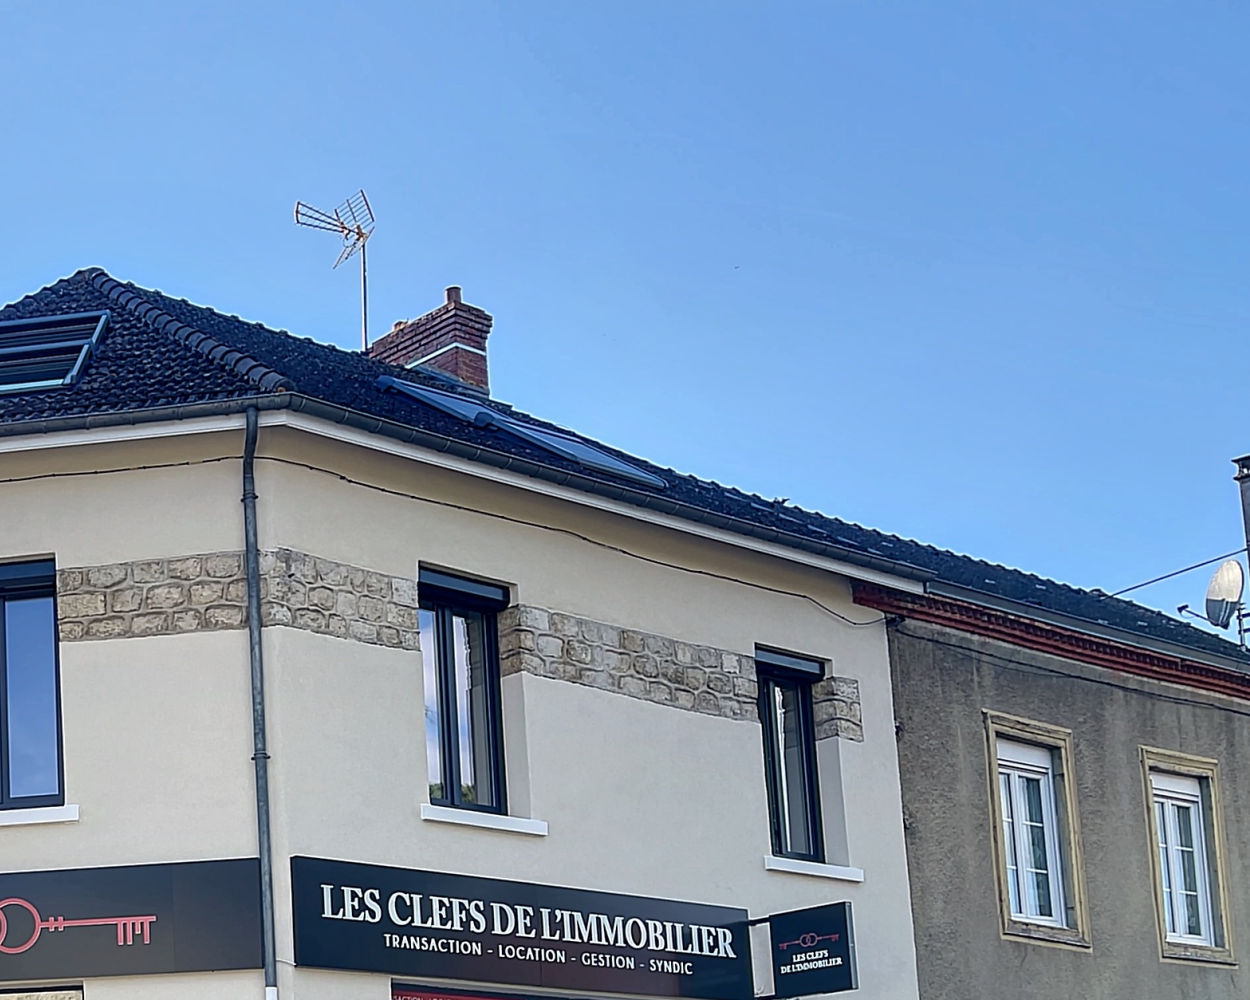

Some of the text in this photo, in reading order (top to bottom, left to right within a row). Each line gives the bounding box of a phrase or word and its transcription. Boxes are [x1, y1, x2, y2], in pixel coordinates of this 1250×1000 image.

[320, 884, 737, 958] LES CLEFS DE L'IMMOBILIER
[383, 933, 482, 955] TRANSACTION
[498, 944, 566, 963] LOCATION
[581, 952, 635, 969] GESTION
[649, 959, 693, 975] SYNDIC
[792, 949, 829, 963] LES CLEFS
